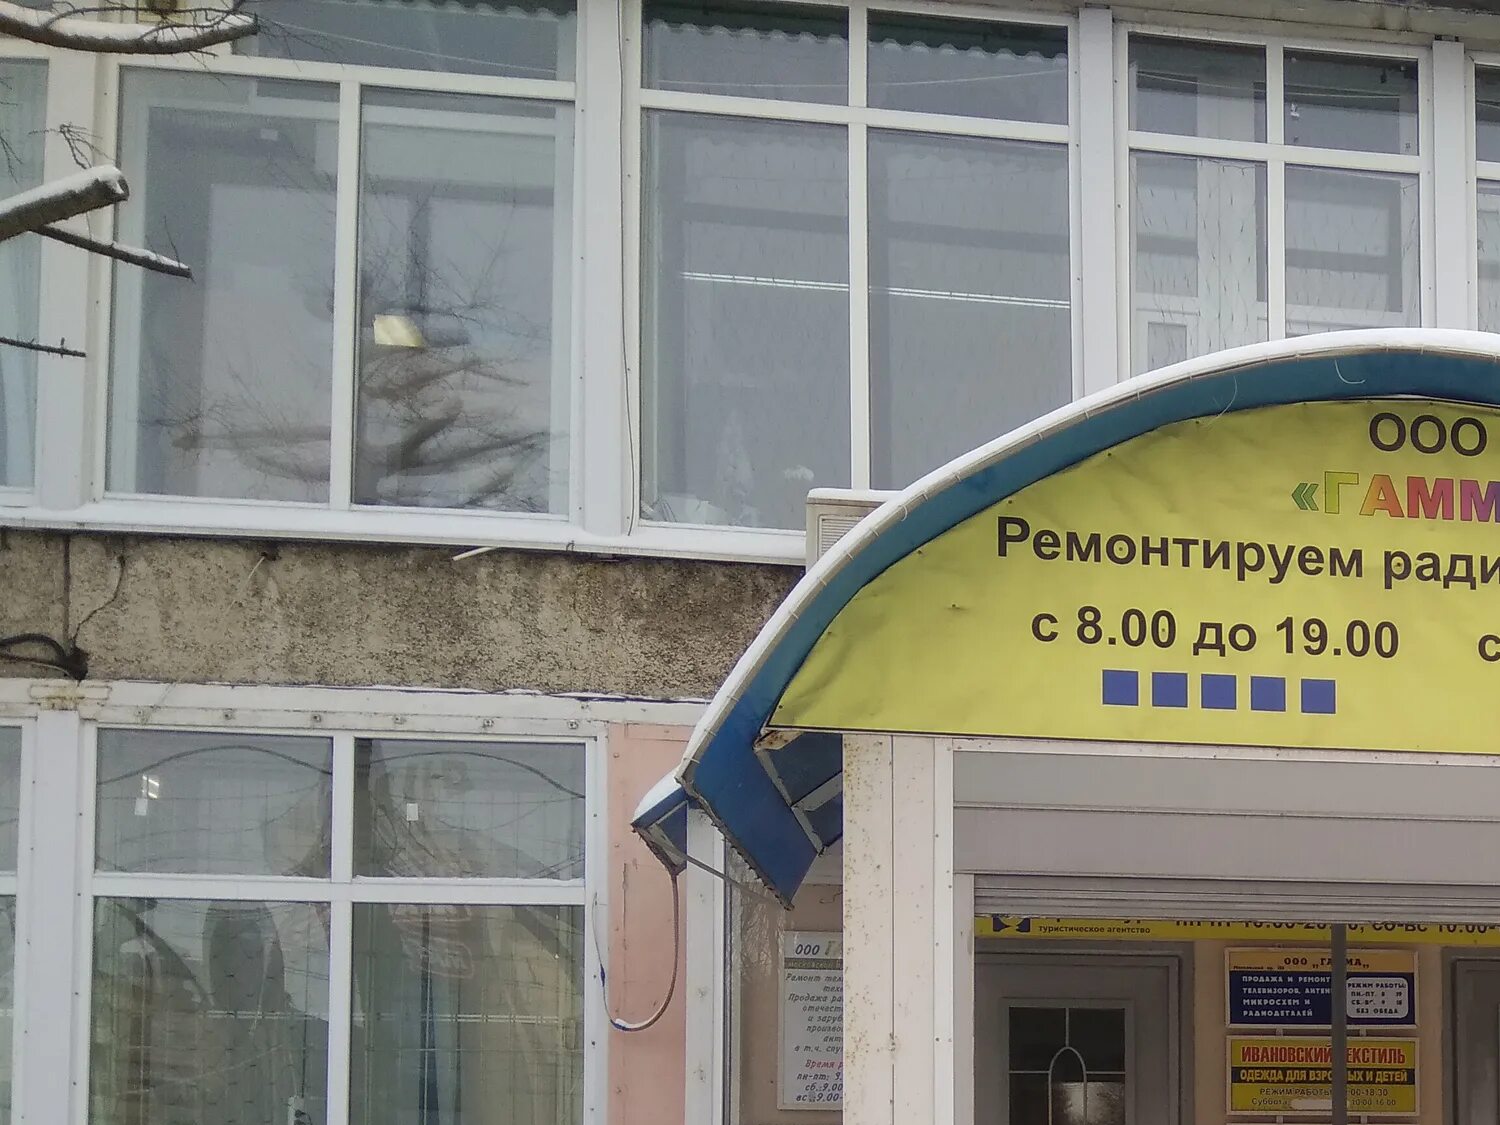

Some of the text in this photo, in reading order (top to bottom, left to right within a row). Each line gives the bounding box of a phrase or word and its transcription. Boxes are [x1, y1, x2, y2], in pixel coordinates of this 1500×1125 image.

[1369, 412, 1488, 456] ООО
[997, 516, 1364, 585] Ремонтируем
[1032, 607, 1399, 658] с 8.00 до 19.00
[1038, 924, 1150, 934] туристическое агентство
[786, 973, 821, 982] Ремонт
[789, 993, 828, 1003] Продажа
[1243, 1009, 1313, 1017] РАДИОДЕТАЛЕЙ
[1241, 1045, 1406, 1065] ИВАНОВСКИЙ ЕКСТИЛЬ
[806, 1059, 835, 1069] Время
[1240, 1070, 1407, 1083] ОДЕЖДА ДЛЯ ВЗРОЫХ И ДЕТЕЙ
[1260, 1088, 1292, 1097] РЕЖИМ
